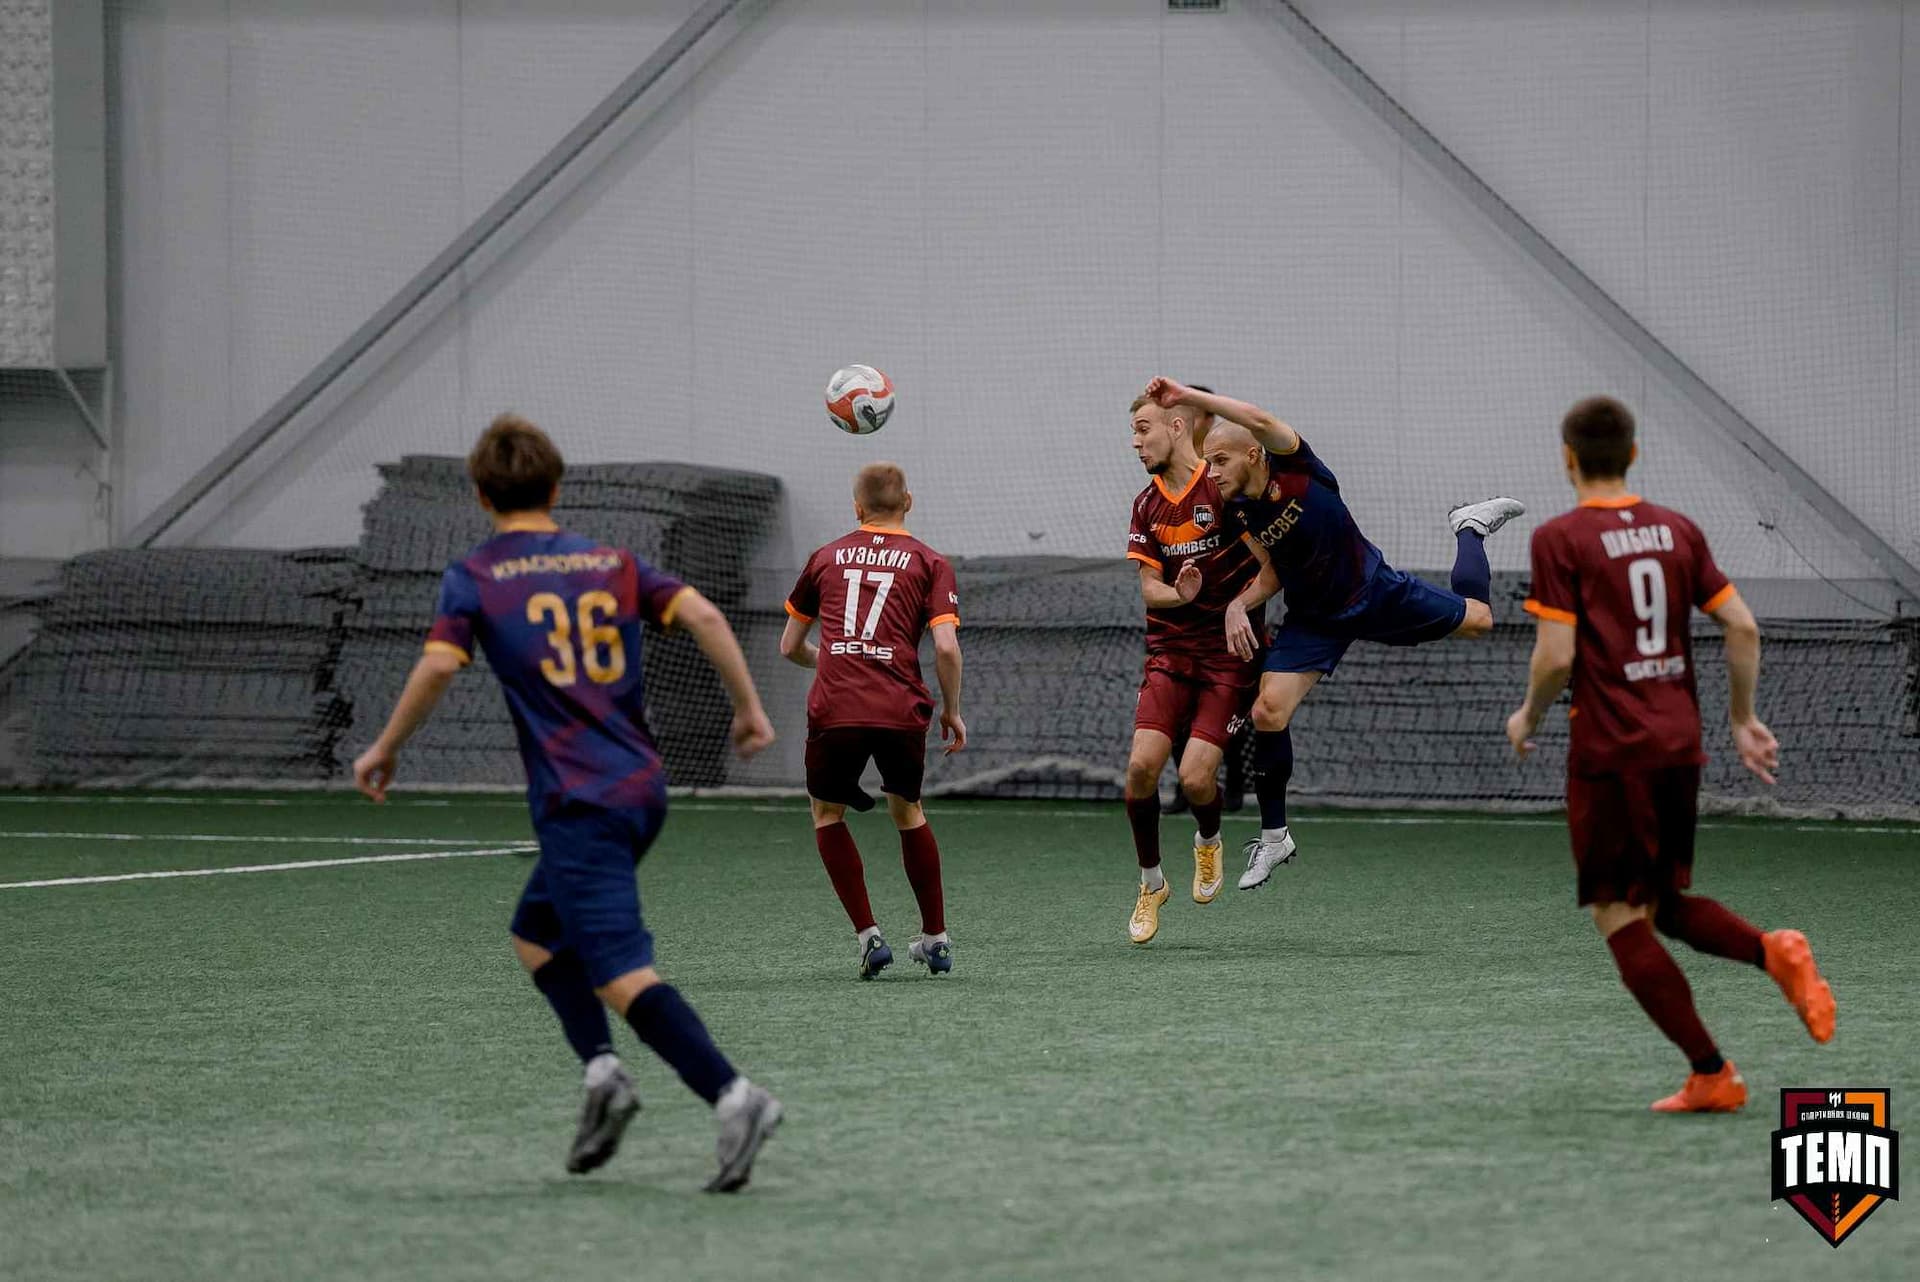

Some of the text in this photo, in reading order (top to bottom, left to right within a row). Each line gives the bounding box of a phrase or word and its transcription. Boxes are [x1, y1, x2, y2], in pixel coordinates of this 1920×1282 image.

[835, 547, 911, 569] КУЗЬКИН
[1260, 499, 1304, 548] ССВЕТ
[526, 590, 625, 686] 36
[843, 569, 894, 640] 17
[1629, 558, 1667, 656] 9
